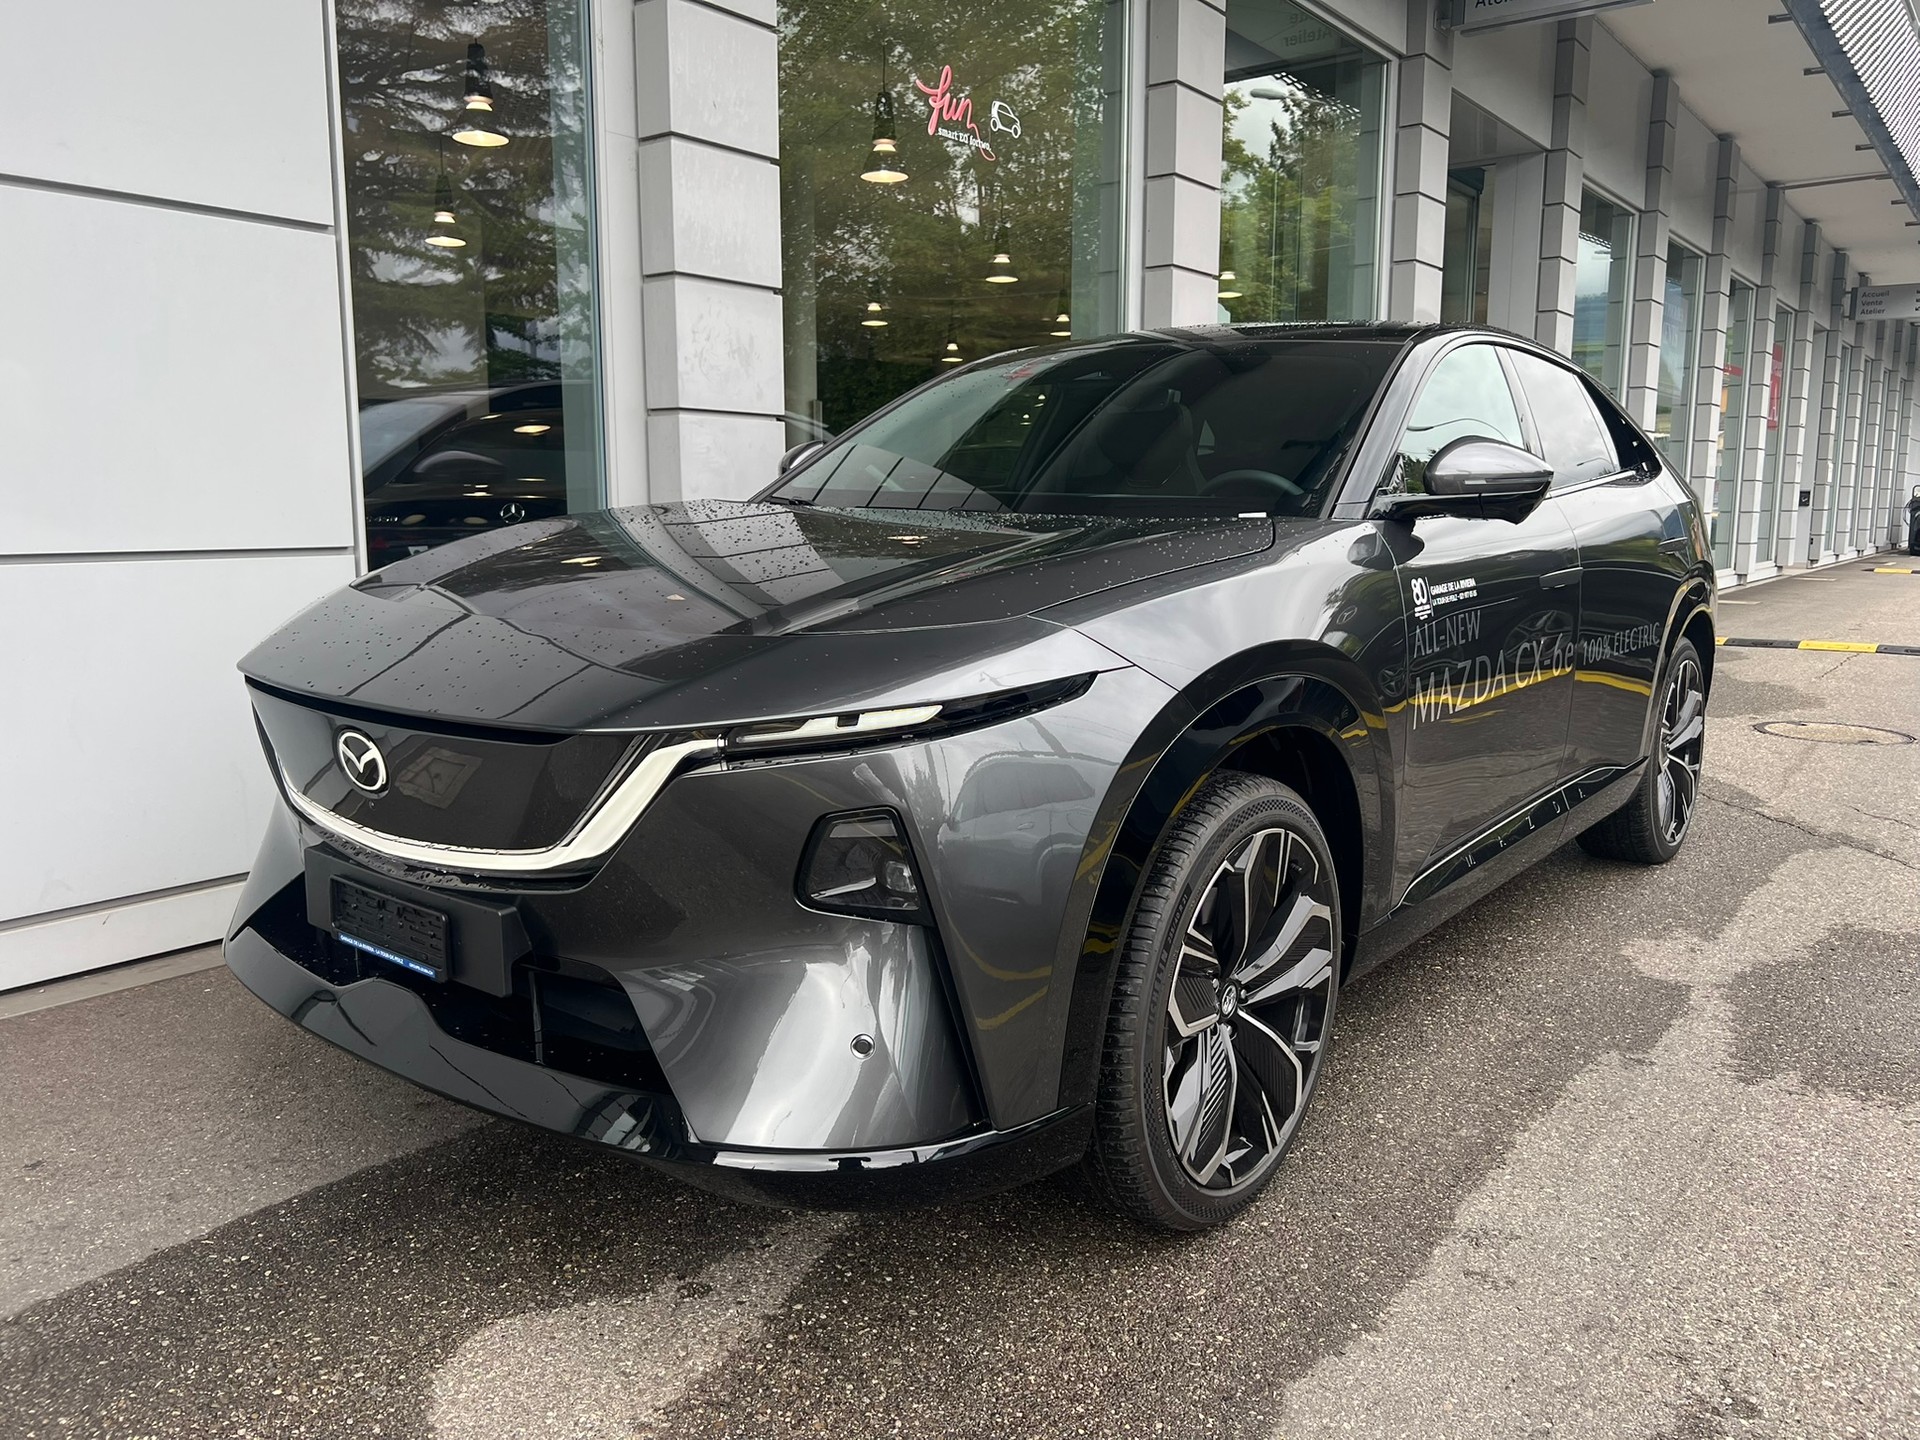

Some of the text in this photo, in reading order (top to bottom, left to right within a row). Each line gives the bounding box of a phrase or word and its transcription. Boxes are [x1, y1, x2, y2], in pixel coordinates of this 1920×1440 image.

[915, 64, 978, 137] fun
[938, 127, 959, 141] smart
[1862, 290, 1890, 298] Accueil
[1411, 577, 1427, 605] 80
[1413, 610, 1481, 659] ALL-NEW
[1413, 620, 1662, 730] MAZDA CX-6e 100% ELECTRIC
